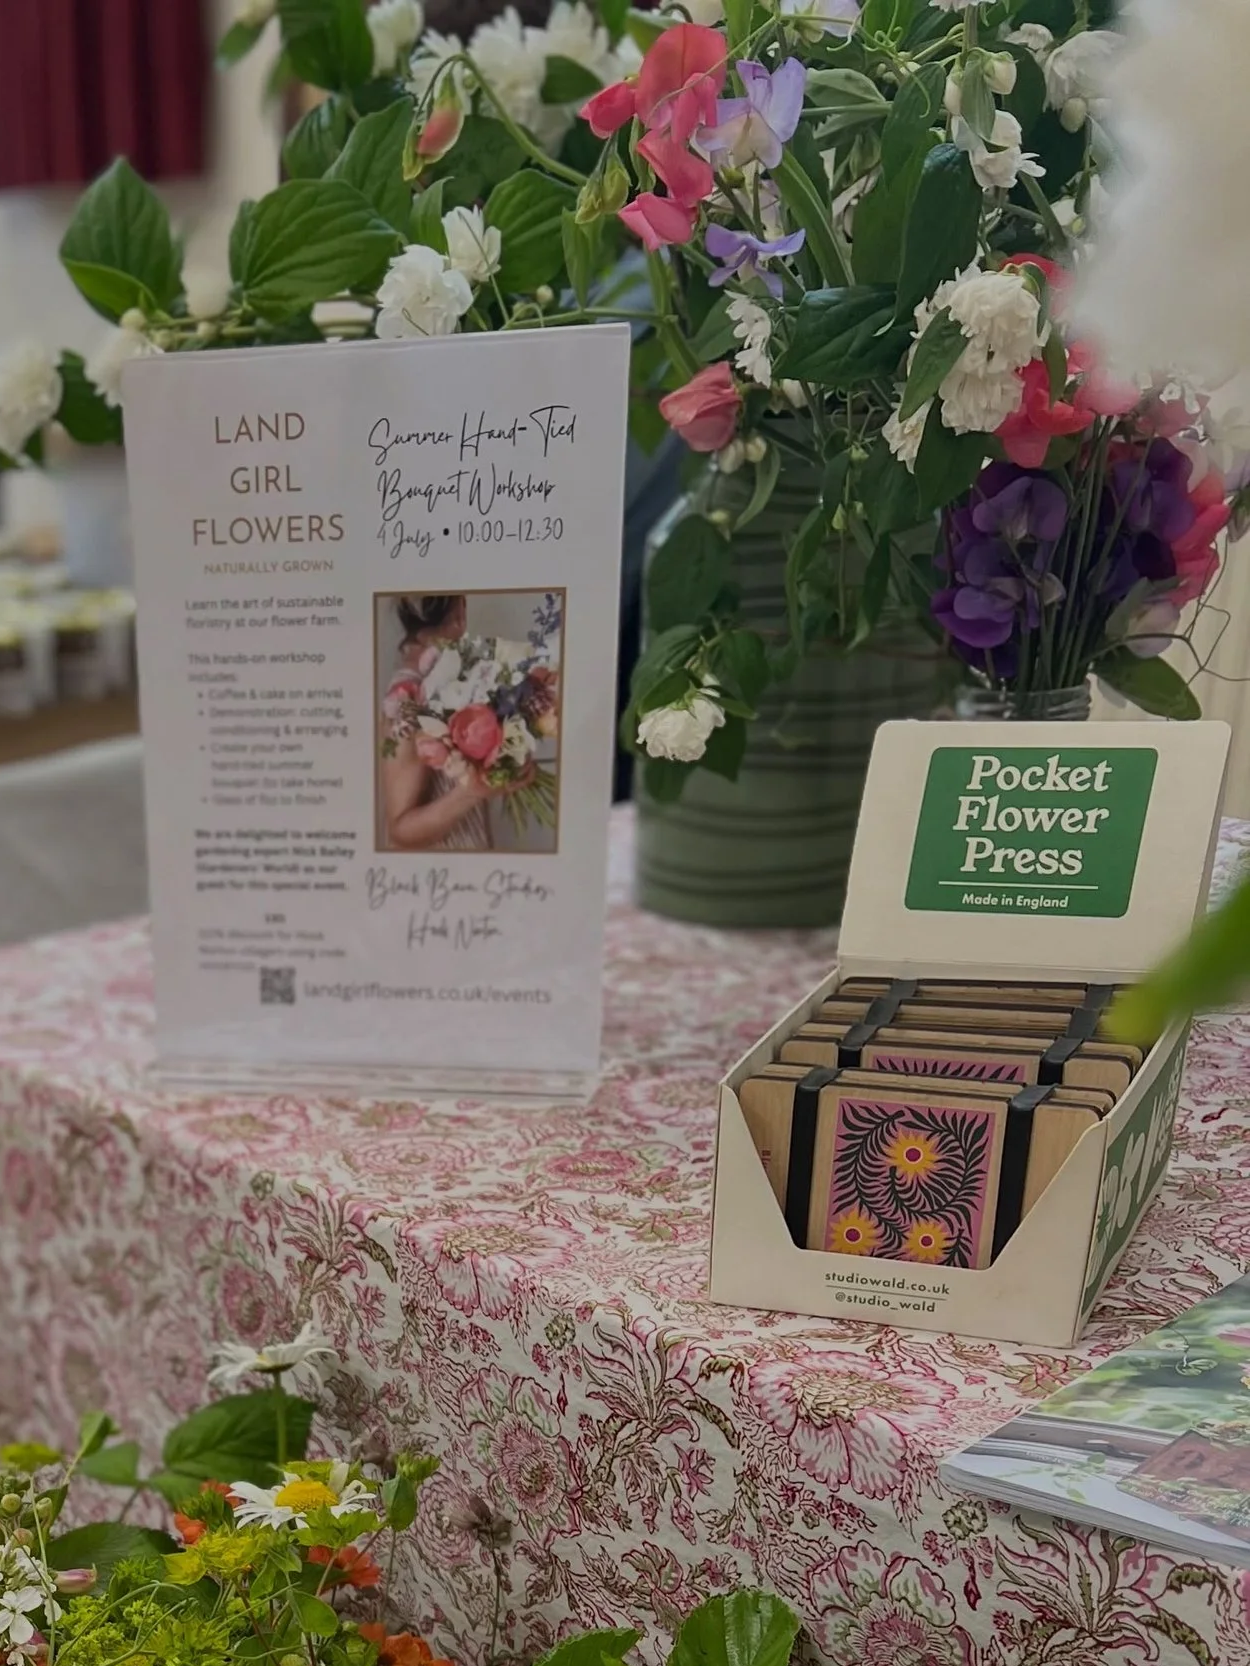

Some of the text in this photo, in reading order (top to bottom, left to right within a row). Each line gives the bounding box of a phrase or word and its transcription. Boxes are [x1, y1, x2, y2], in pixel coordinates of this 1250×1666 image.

[214, 412, 305, 444] LAND
[368, 417, 454, 466] Summer
[230, 464, 302, 494] GIRL
[377, 462, 556, 522] Bouquet Workshop
[192, 513, 345, 546] FLOWERS
[376, 521, 386, 546] 4
[390, 520, 436, 559] July
[203, 559, 334, 575] NATURALLY GROWN
[185, 595, 344, 611] Learn the art of sustainable
[235, 617, 246, 628] at
[249, 617, 268, 628] our
[271, 614, 308, 628] flower
[310, 614, 343, 626] farm.
[188, 651, 326, 667] This hands-on workshop
[208, 687, 344, 700] Coffee & cake on arrival
[966, 754, 1113, 792] Pocket
[952, 794, 1110, 834] Flower
[960, 836, 1083, 875] Press
[962, 893, 1069, 910] Made in England
[303, 981, 552, 1004] landgirlflowers.co.uk/events
[824, 1272, 950, 1295] studiowald.co.uk
[835, 1291, 936, 1313] @studio_wald
